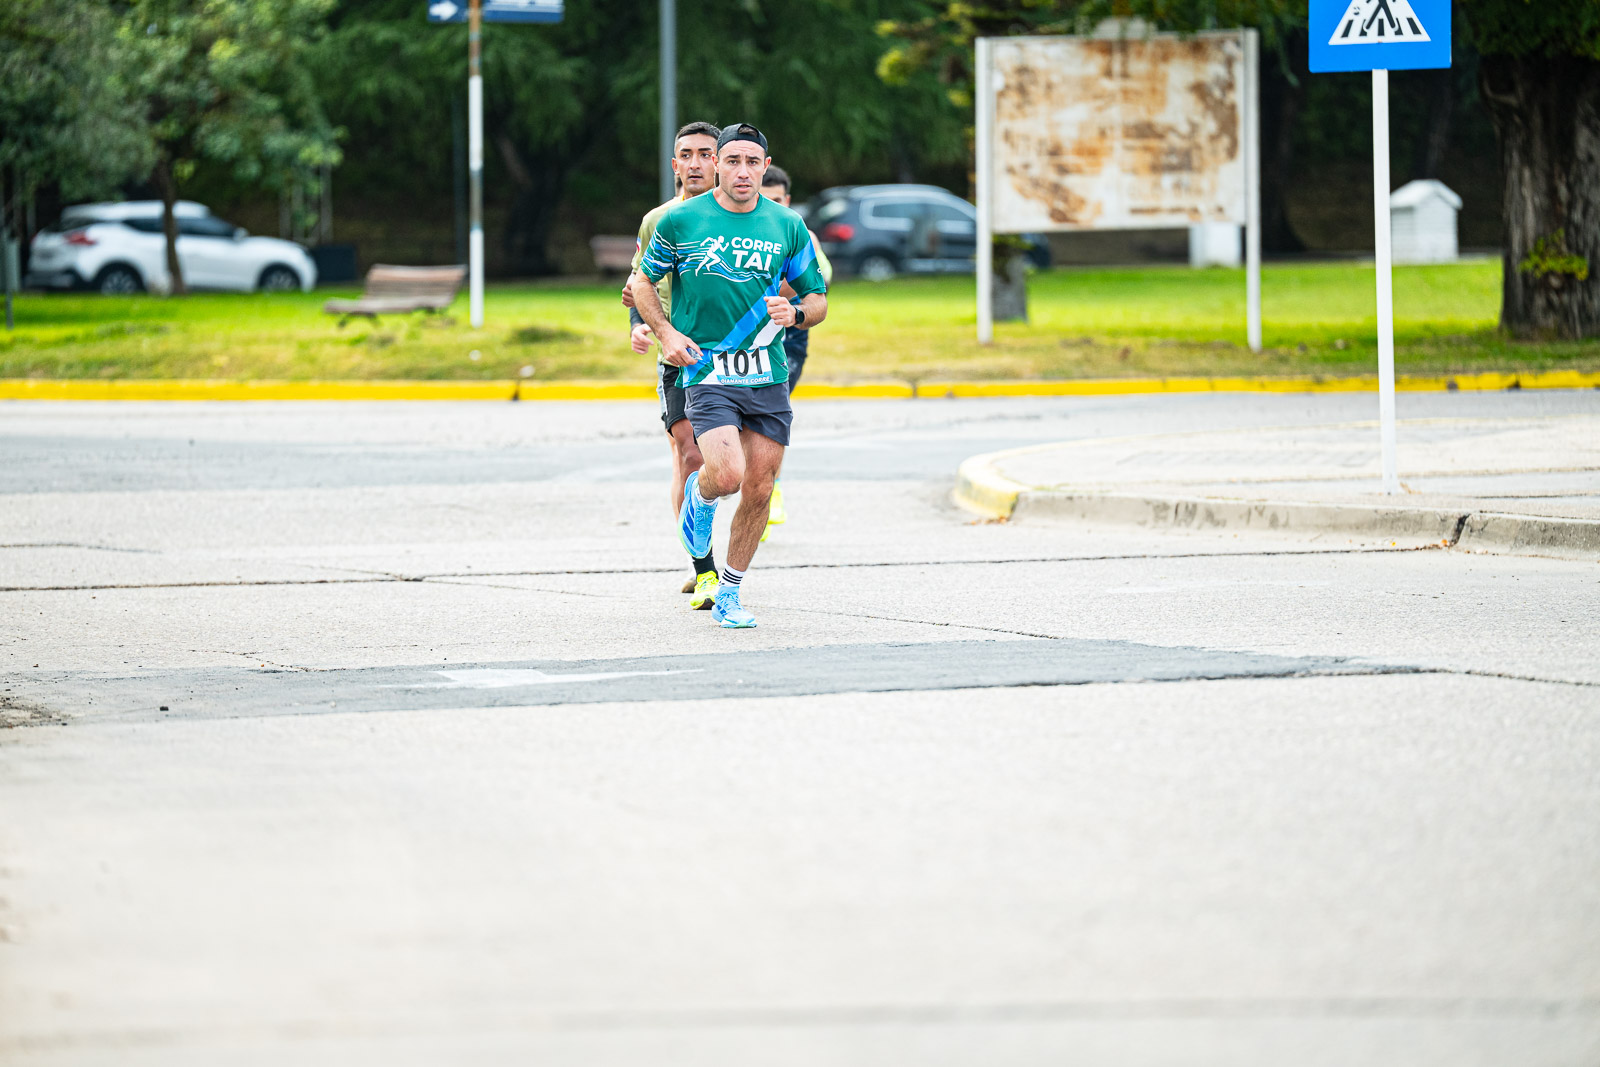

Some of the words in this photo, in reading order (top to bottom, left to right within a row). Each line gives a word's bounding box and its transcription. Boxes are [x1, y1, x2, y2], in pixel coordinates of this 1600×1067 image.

[731, 236, 782, 254] CORRE
[732, 250, 772, 271] TAI
[717, 347, 763, 377] 101
